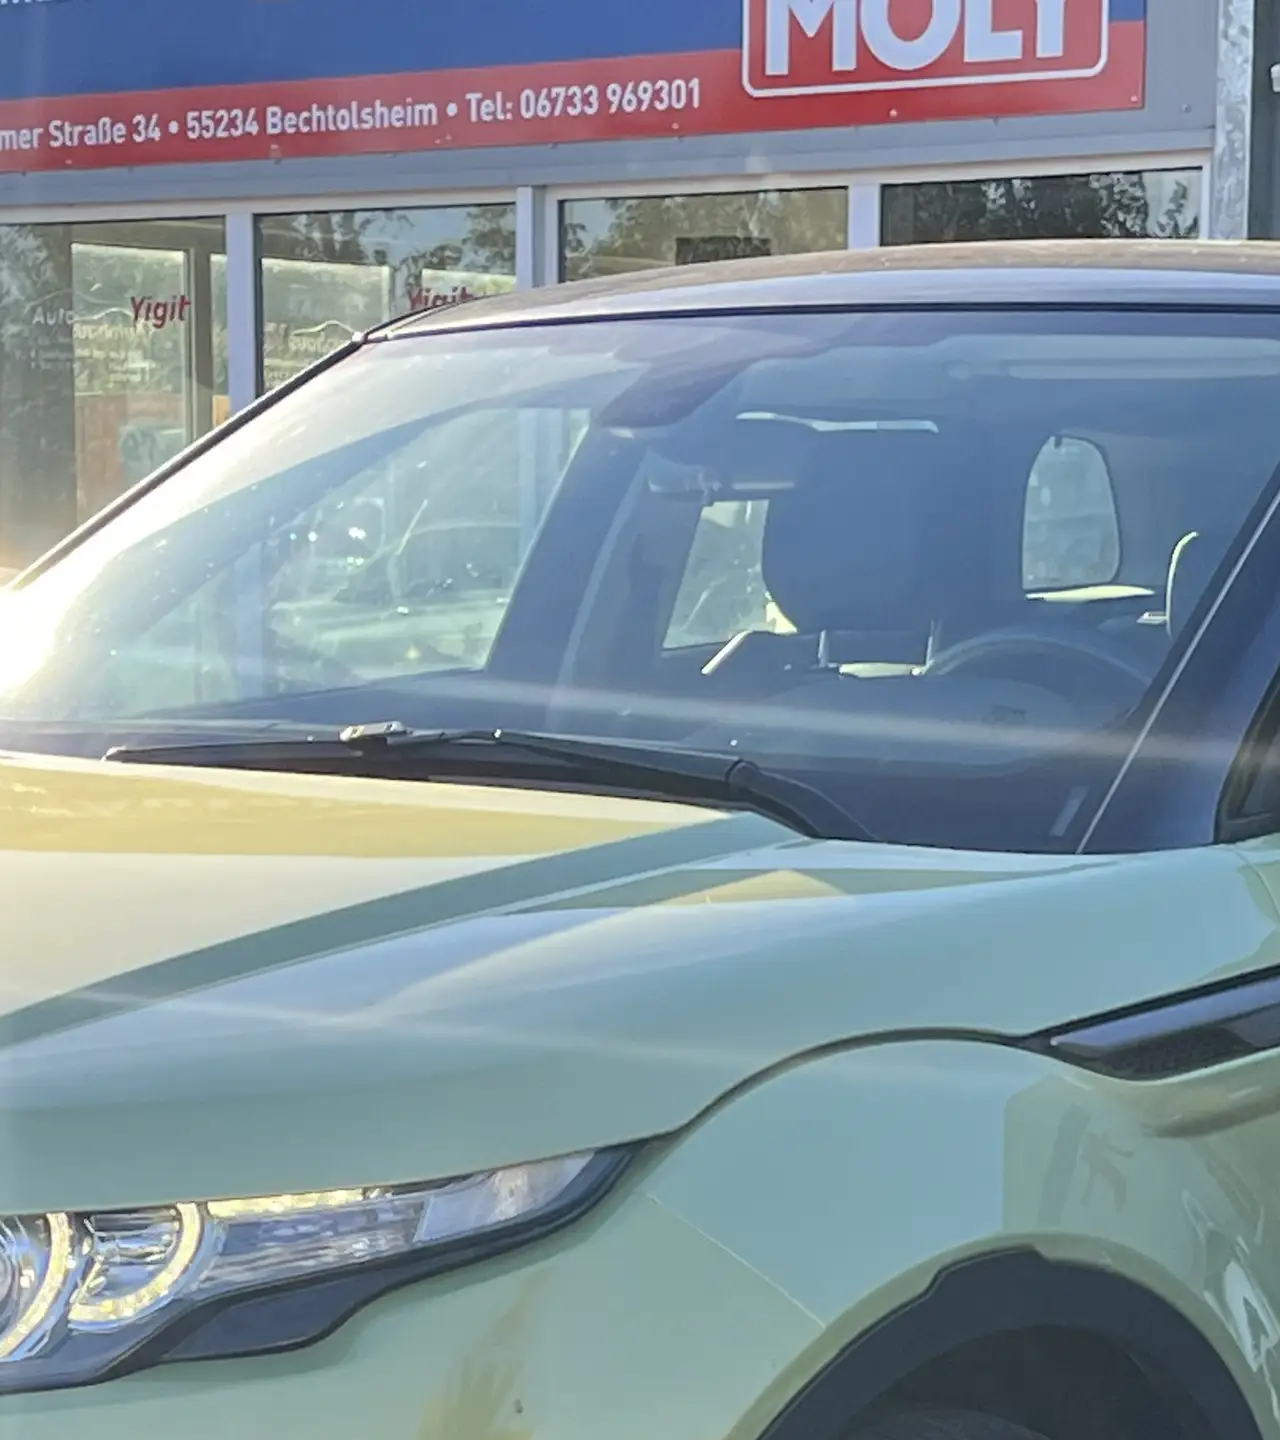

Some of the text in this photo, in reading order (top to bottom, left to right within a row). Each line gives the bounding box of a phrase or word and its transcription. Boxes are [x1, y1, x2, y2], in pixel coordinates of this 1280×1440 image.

[48, 116, 126, 147] Straße
[132, 112, 162, 143] 34
[187, 106, 259, 139] 55234
[265, 97, 439, 136] Bechtolsheim
[466, 91, 514, 122] Tel:
[520, 87, 599, 120] 06733
[606, 77, 701, 114] 969301
[130, 294, 191, 329] Yigit
